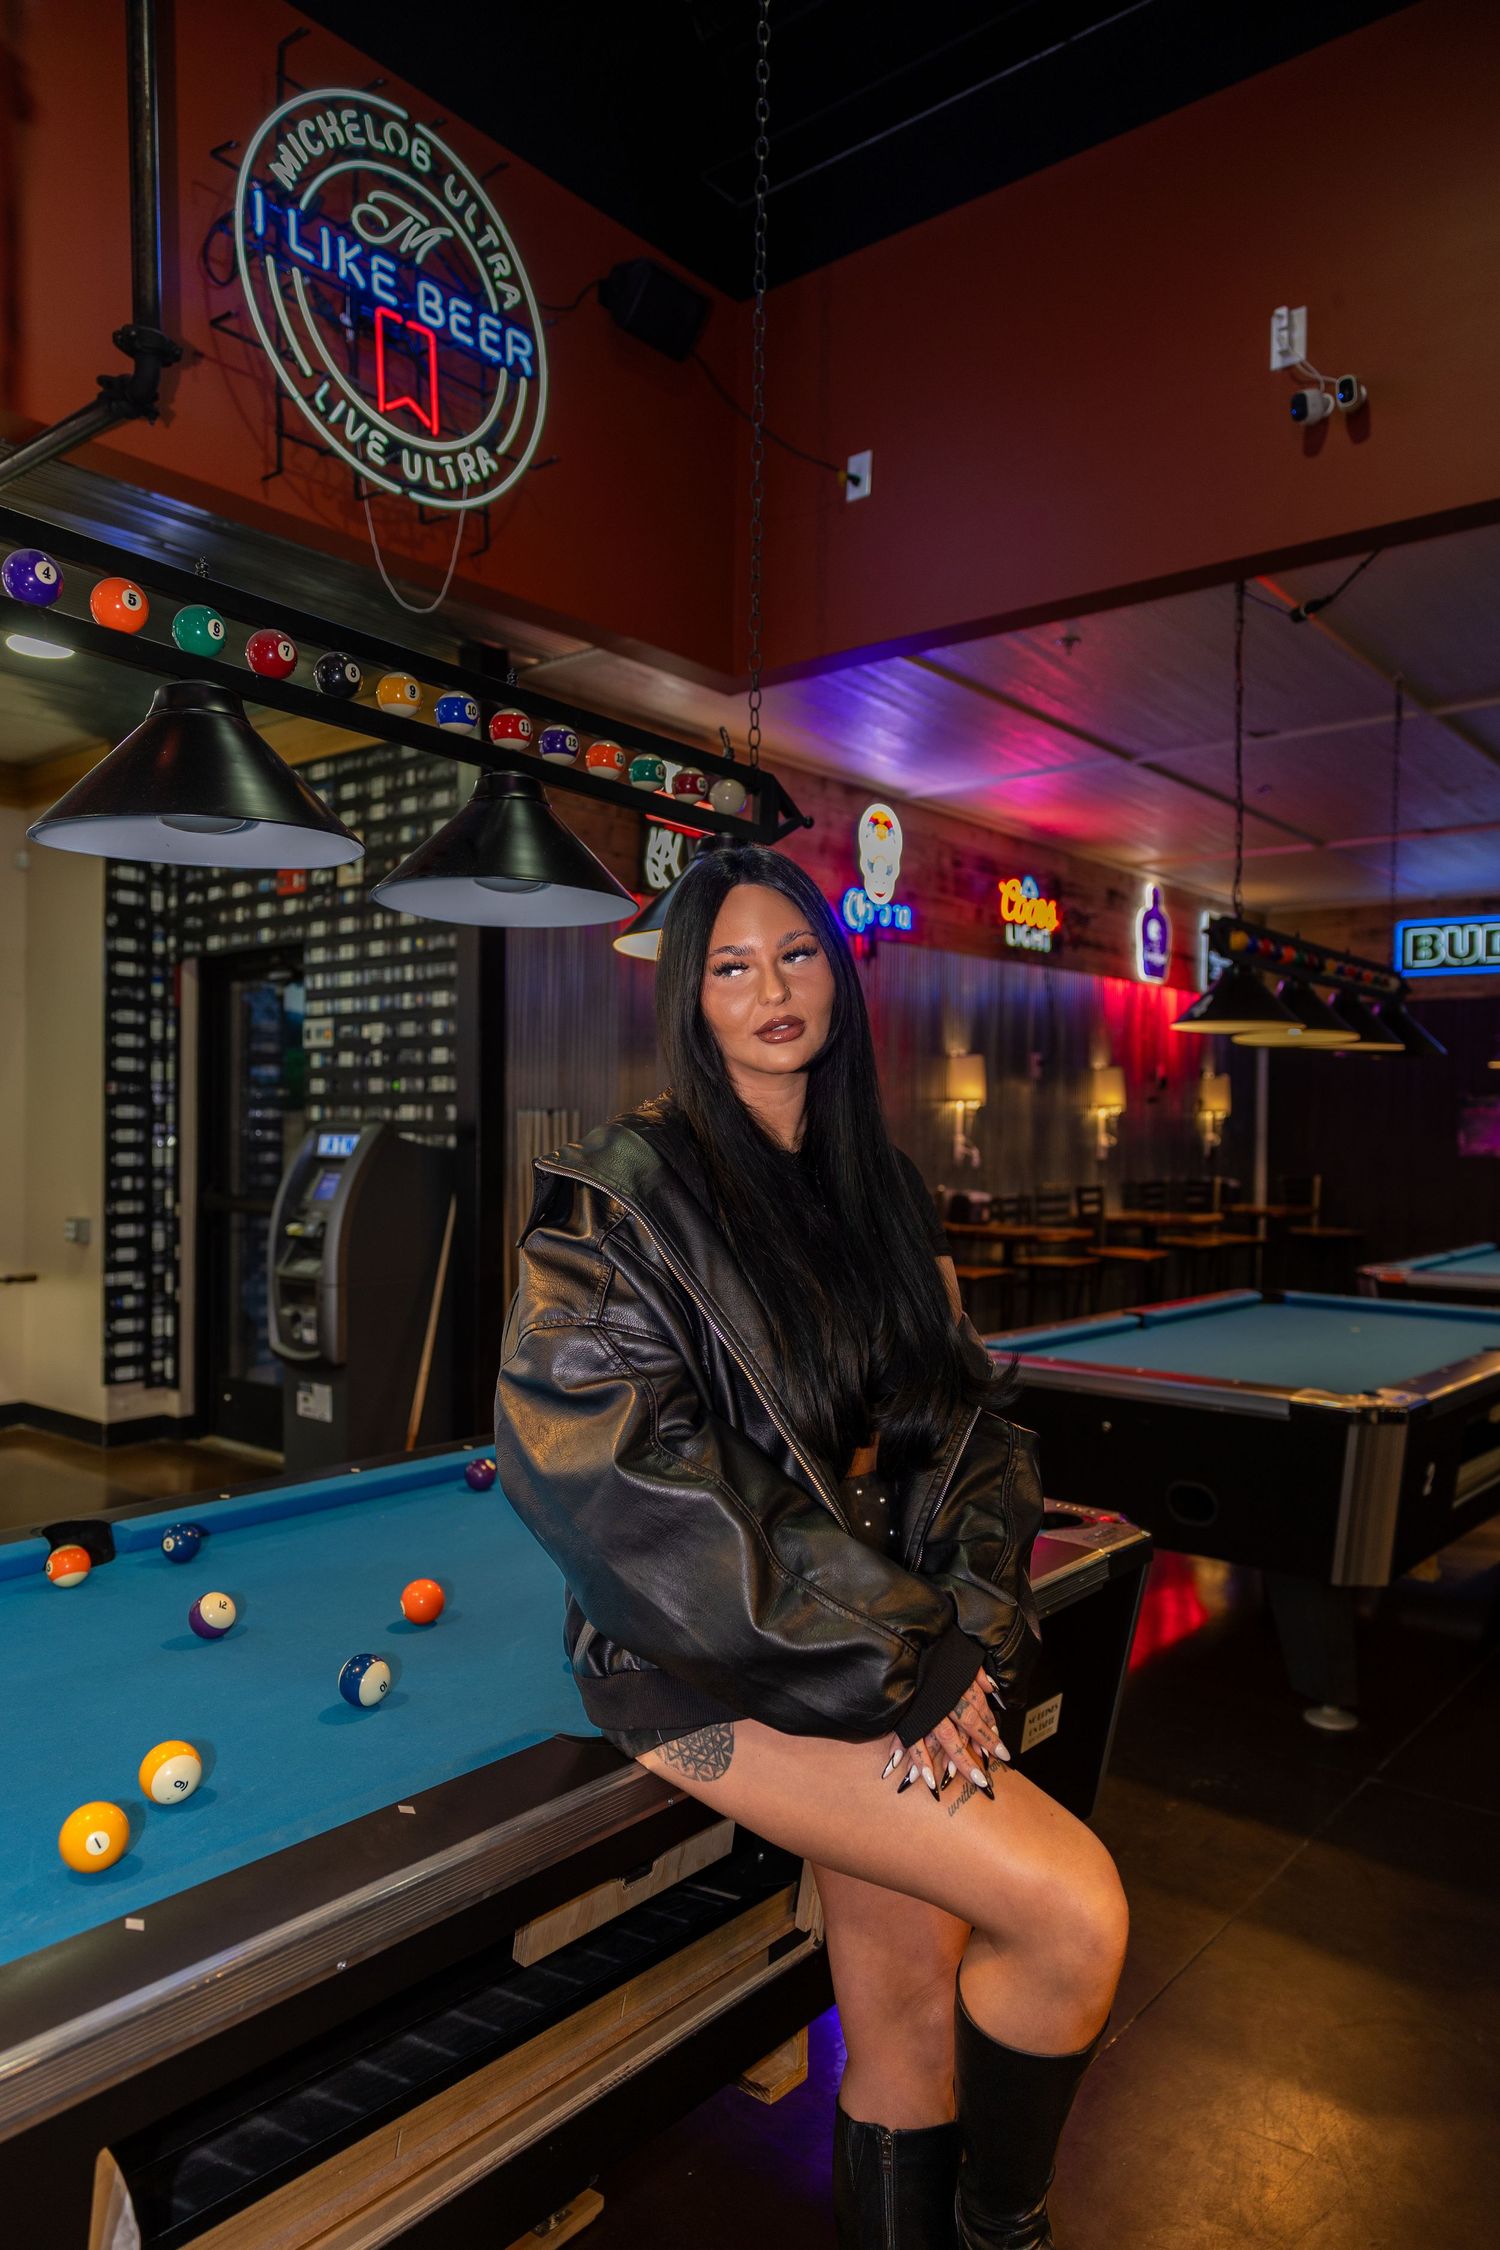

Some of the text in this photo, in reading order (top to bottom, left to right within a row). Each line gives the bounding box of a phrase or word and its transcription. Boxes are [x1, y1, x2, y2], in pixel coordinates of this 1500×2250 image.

[269, 109, 521, 310] MICHELOB ULTRA
[253, 189, 534, 377] I LIKE BEER
[314, 381, 499, 490] LIVE ULTRA
[42, 566, 51, 580] 4
[127, 593, 137, 606] 5
[213, 622, 221, 635] 6
[283, 644, 290, 657] 7
[350, 667, 357, 678] 8
[409, 685, 416, 697] 9
[467, 704, 477, 716] 10
[521, 721, 529, 733] 11
[568, 737, 577, 748] 12
[218, 1600, 228, 1610] 12
[94, 1837, 102, 1849] 1
